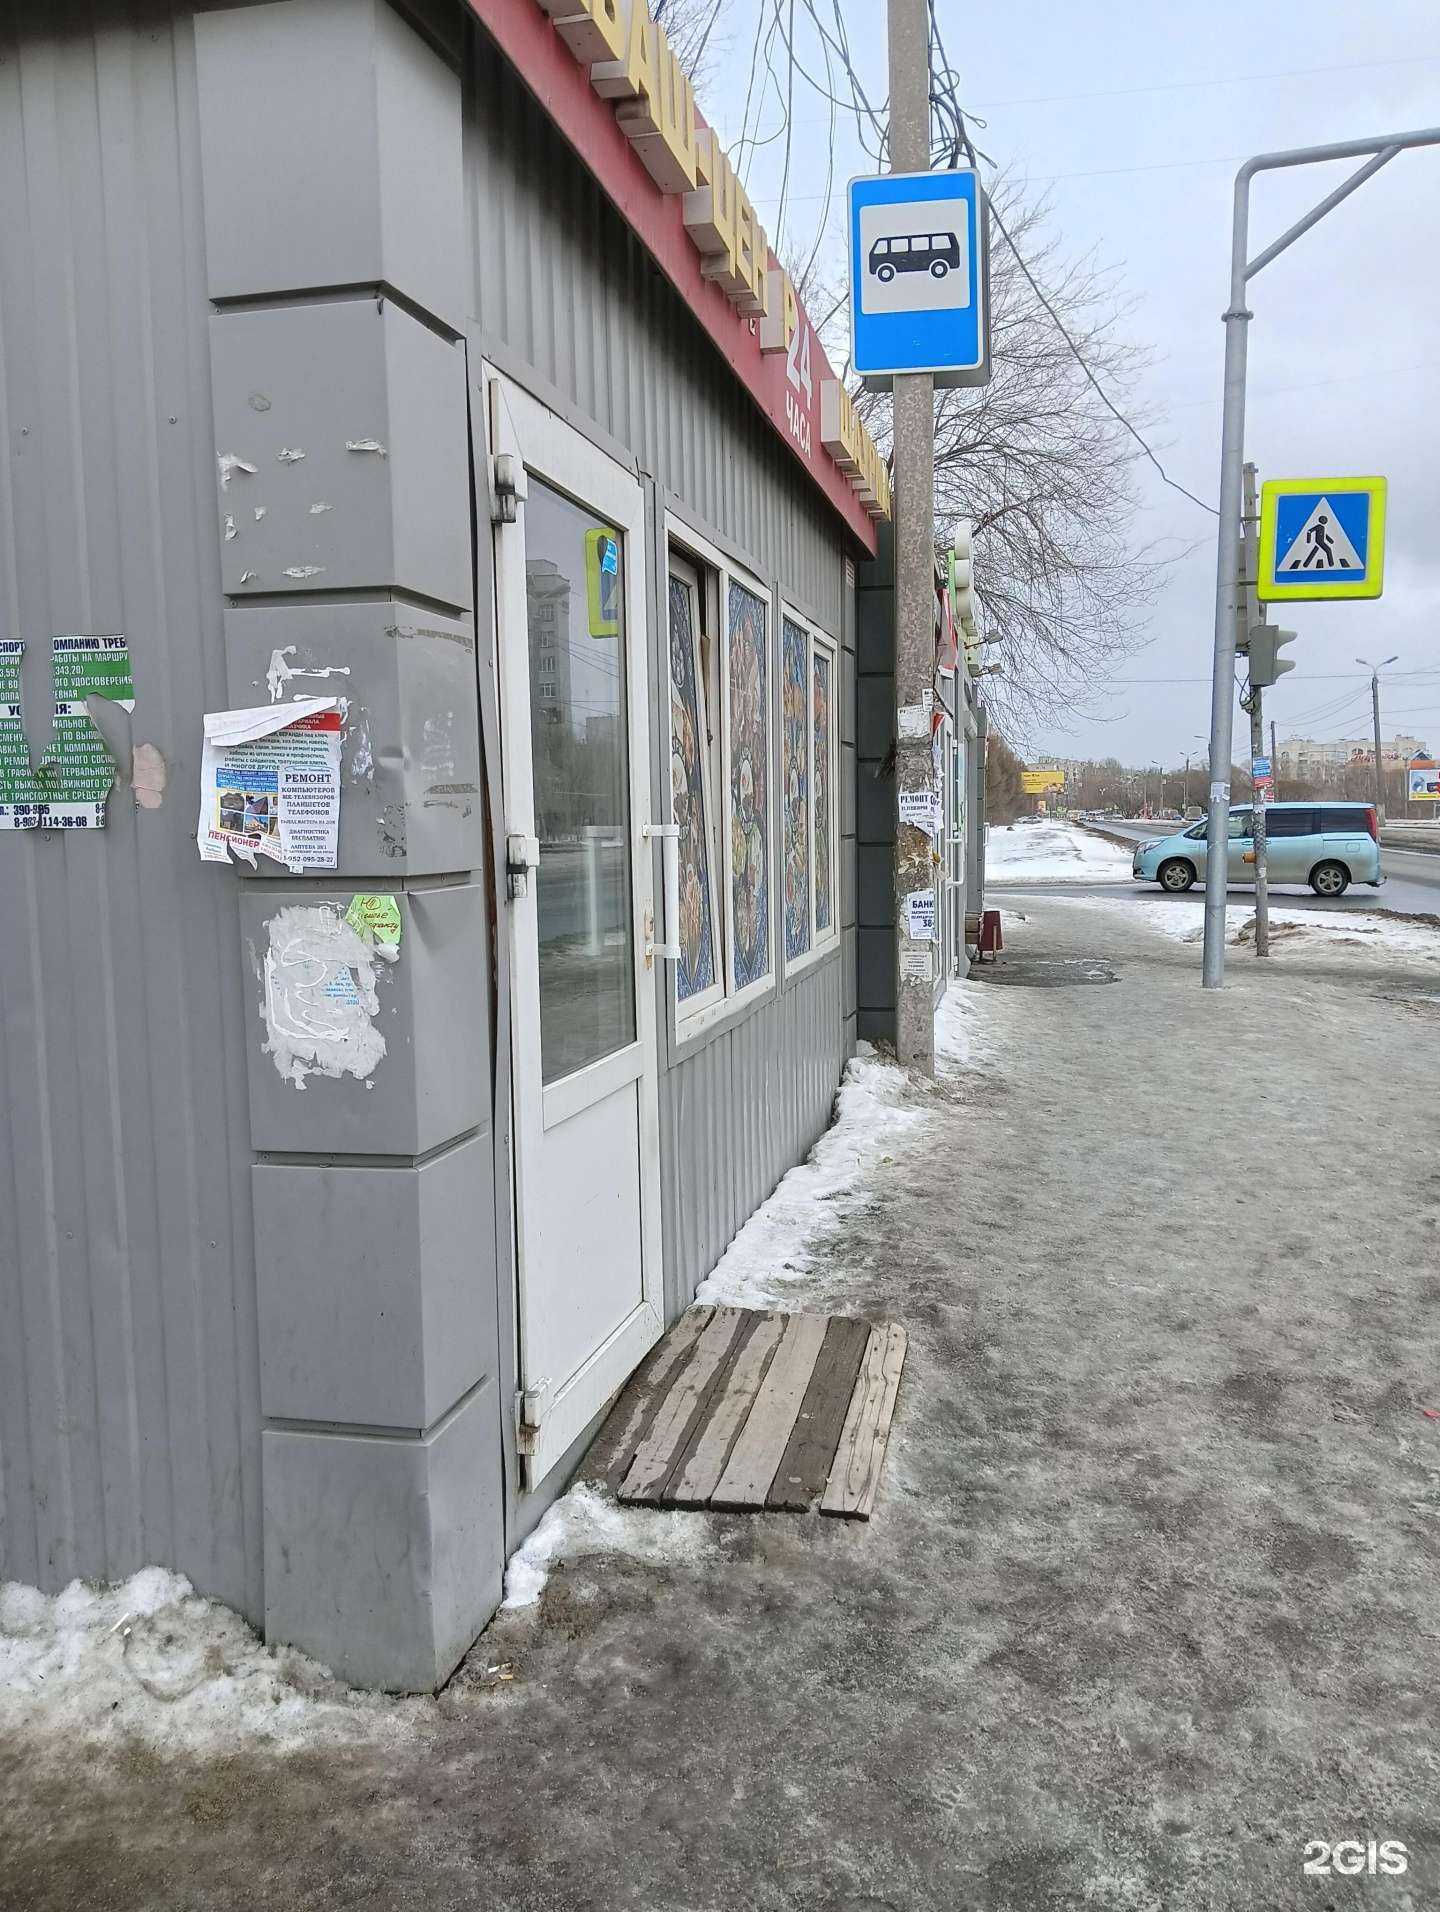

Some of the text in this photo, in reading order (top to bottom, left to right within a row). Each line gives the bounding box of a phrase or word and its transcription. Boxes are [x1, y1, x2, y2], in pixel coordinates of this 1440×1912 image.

[787, 389, 812, 460] ЧАСА
[103, 637, 126, 650] ТРЕБ
[82, 653, 92, 662] НА
[53, 678, 68, 687] ОГО
[53, 689, 78, 699] ЕВНАЯ
[63, 731, 73, 741] ПО
[44, 743, 61, 753] ЧЕТ
[286, 773, 332, 782] РЕМОНТ
[901, 795, 929, 804] РЕМОНТ
[208, 831, 261, 849] ПЕНСИОНЕР
